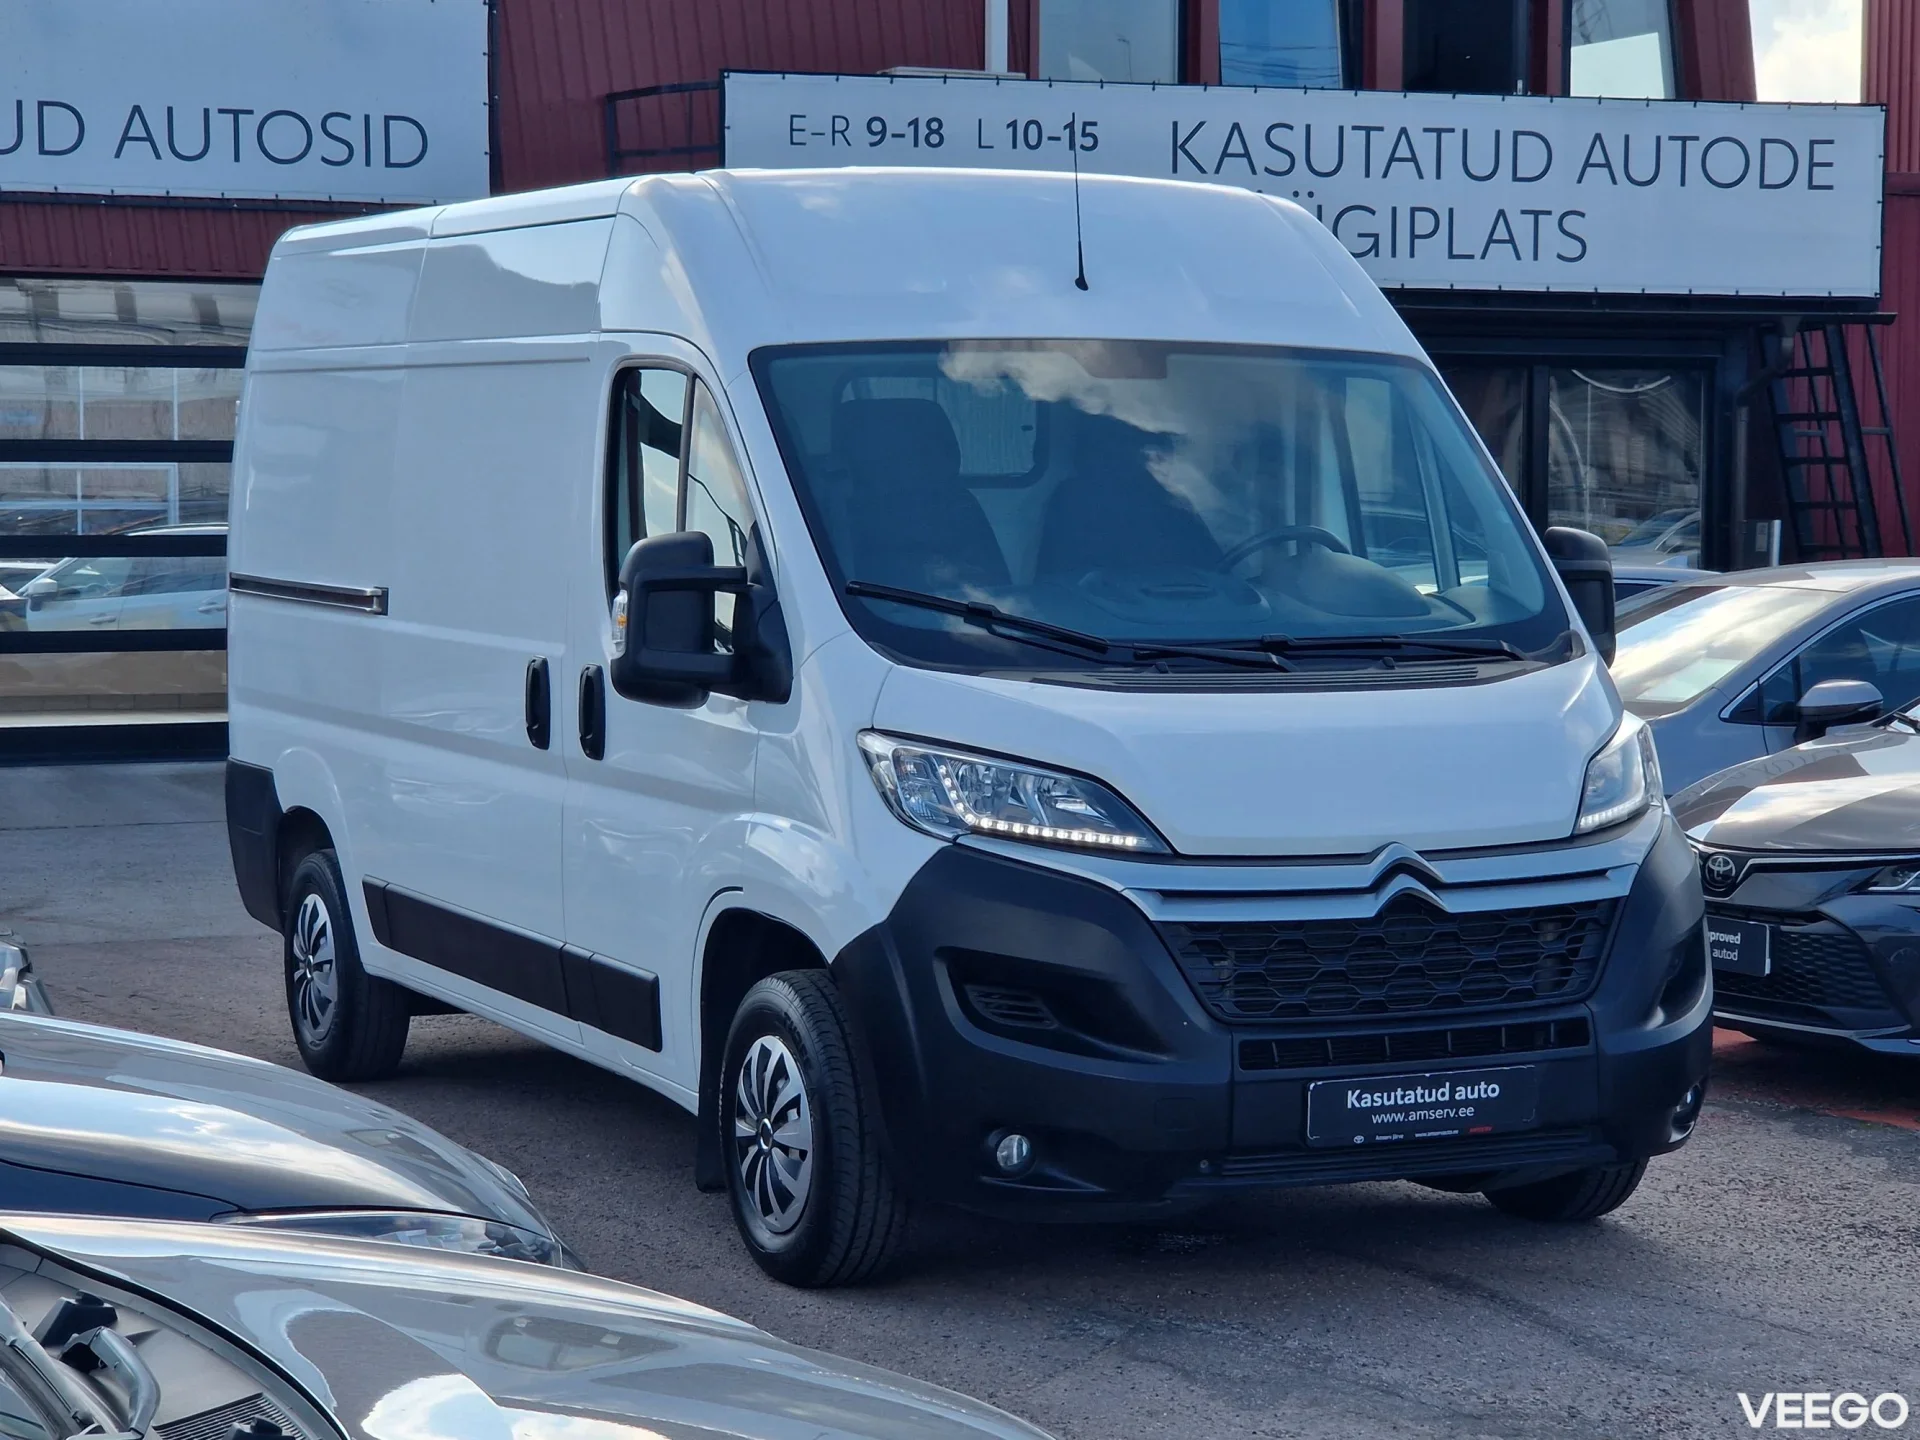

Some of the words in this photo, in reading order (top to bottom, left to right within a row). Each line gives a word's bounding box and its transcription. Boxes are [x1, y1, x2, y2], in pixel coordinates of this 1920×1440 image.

[114, 104, 428, 168] AUTOSID
[789, 114, 852, 147] E-R
[866, 116, 945, 148] 9-18
[978, 118, 994, 149] L
[1005, 119, 1099, 151] 10-15
[1171, 120, 1553, 183] KASUTATUD
[1576, 132, 1835, 190] AUTODE
[1708, 931, 1741, 944] proved
[1347, 1082, 1450, 1109] Kasutatud
[1455, 1081, 1500, 1100] auto
[1372, 1106, 1475, 1124] www.amserv.ee
